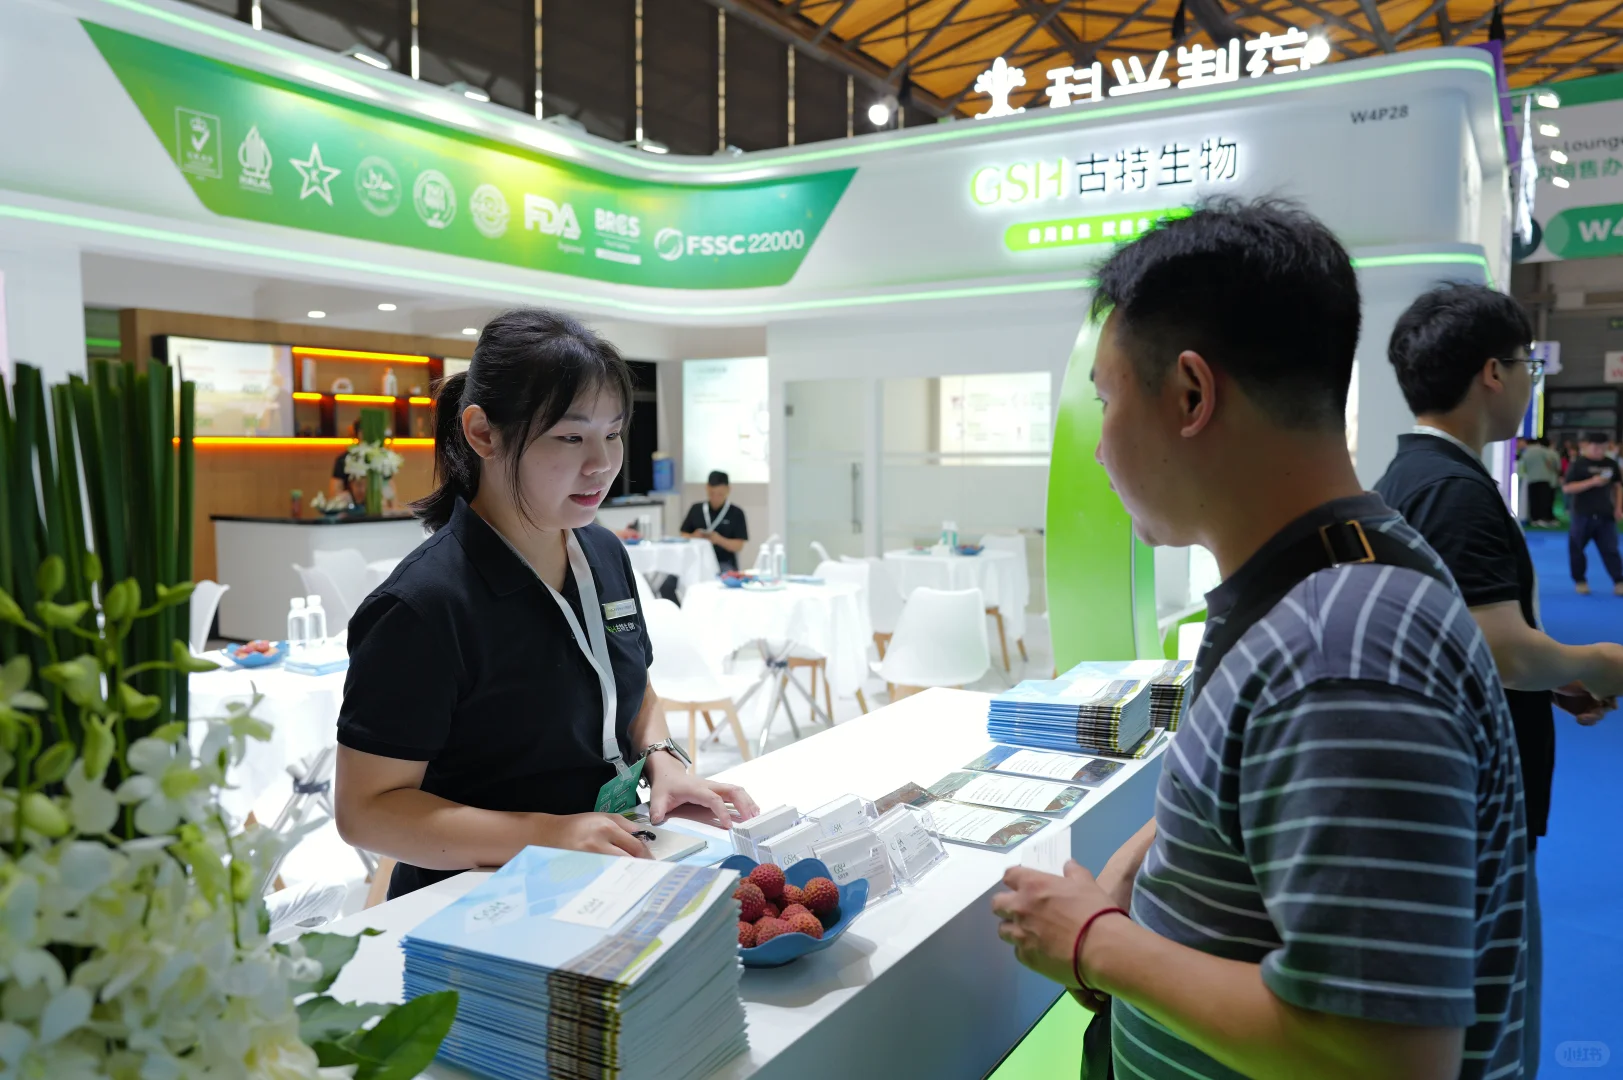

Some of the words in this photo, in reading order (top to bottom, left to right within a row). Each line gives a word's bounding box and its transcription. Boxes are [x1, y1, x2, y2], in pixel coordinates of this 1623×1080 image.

[1350, 105, 1408, 124] W4P28
[970, 158, 1063, 206] GSH
[1076, 137, 1237, 195] 古特生物
[524, 193, 582, 240] FDA
[687, 235, 746, 256] FSSC
[748, 229, 805, 253] 22000
